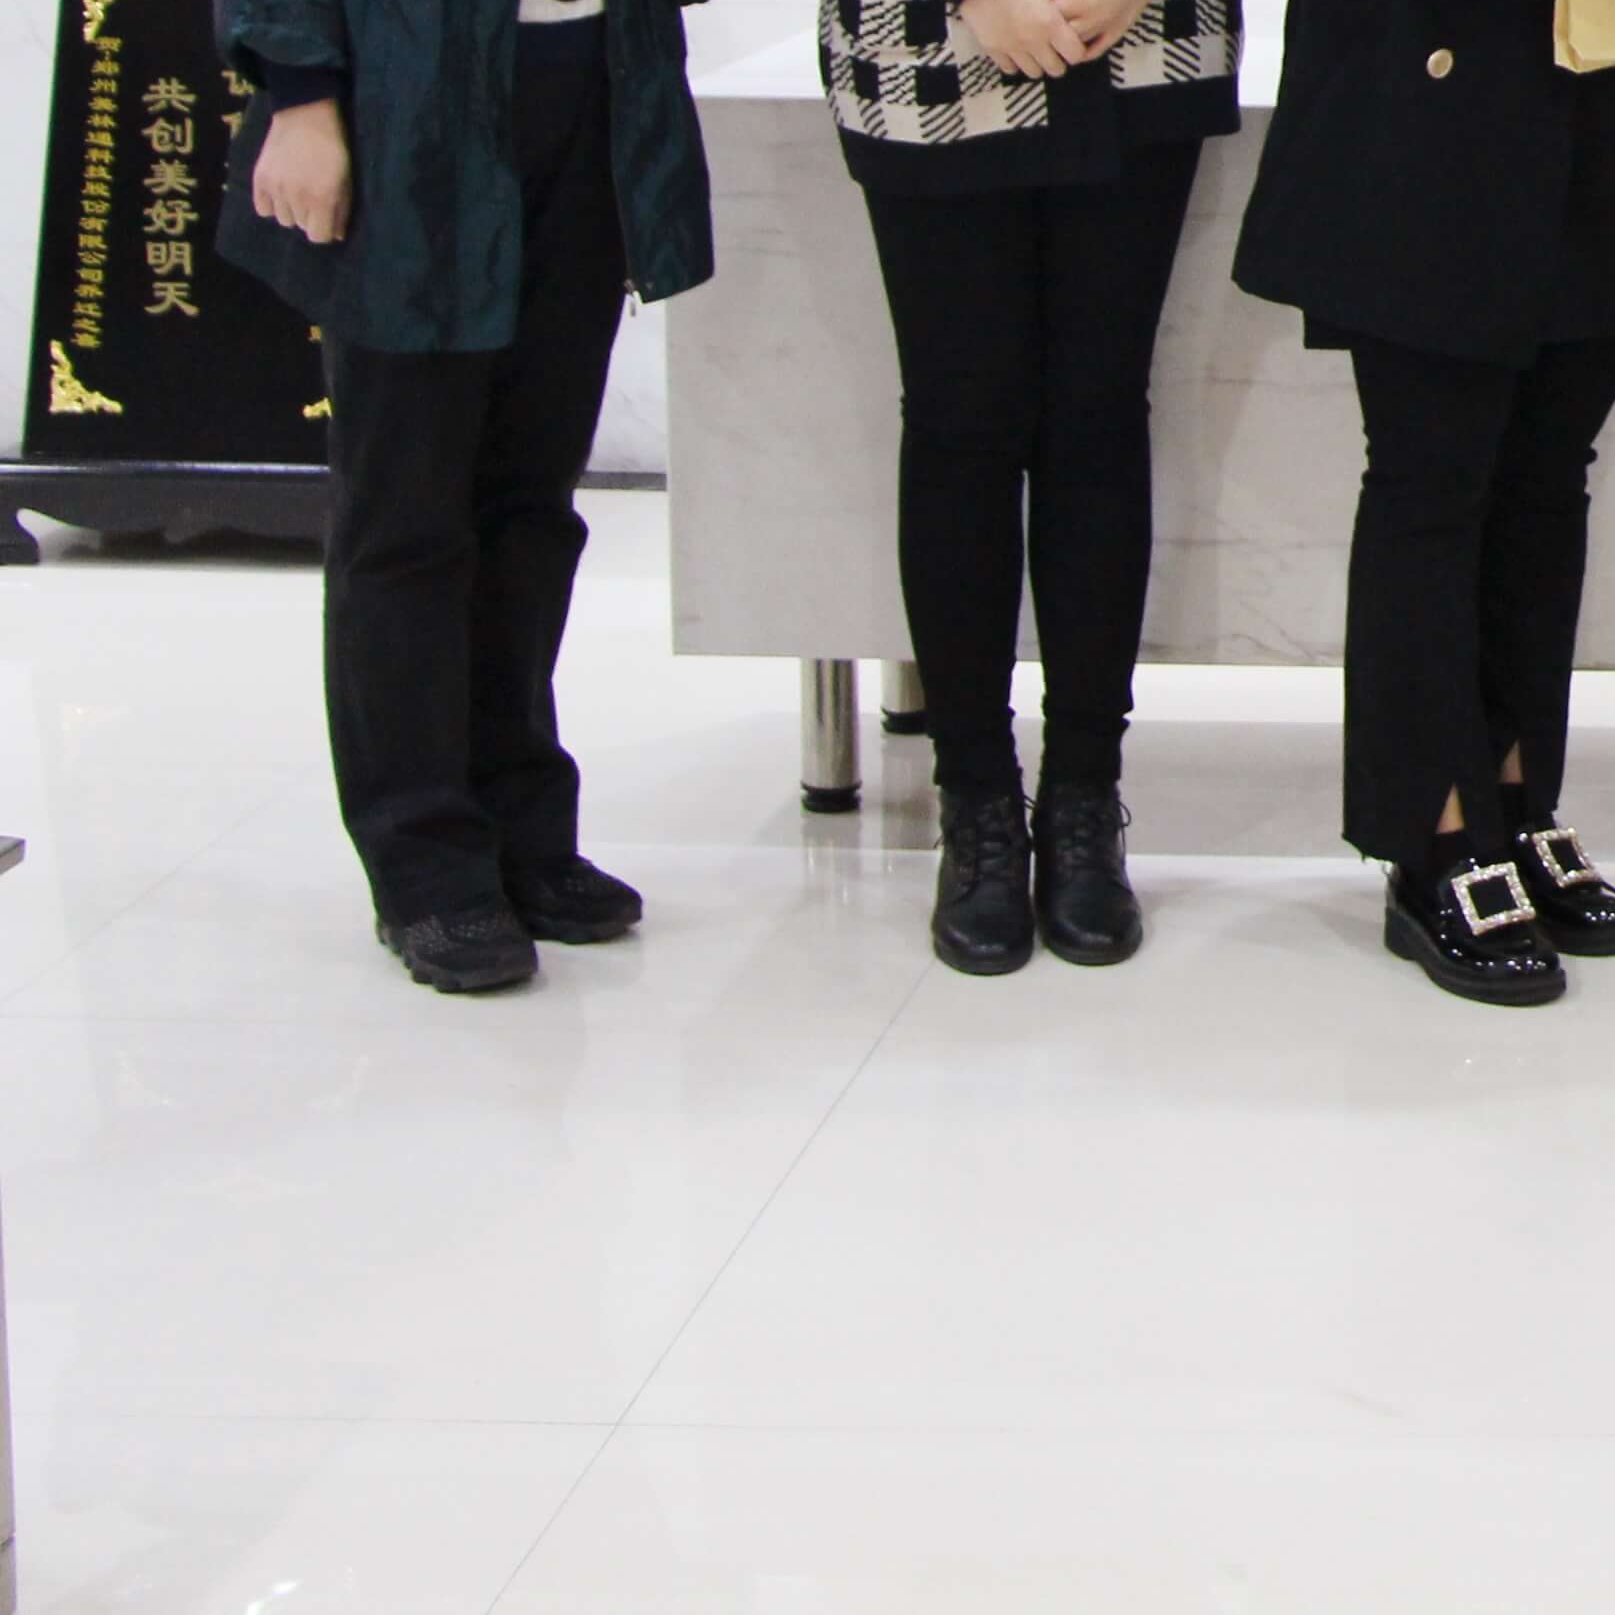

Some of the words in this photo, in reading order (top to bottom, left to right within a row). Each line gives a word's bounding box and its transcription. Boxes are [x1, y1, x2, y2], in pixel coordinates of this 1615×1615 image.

[141, 76, 200, 316] 共创美好明天
